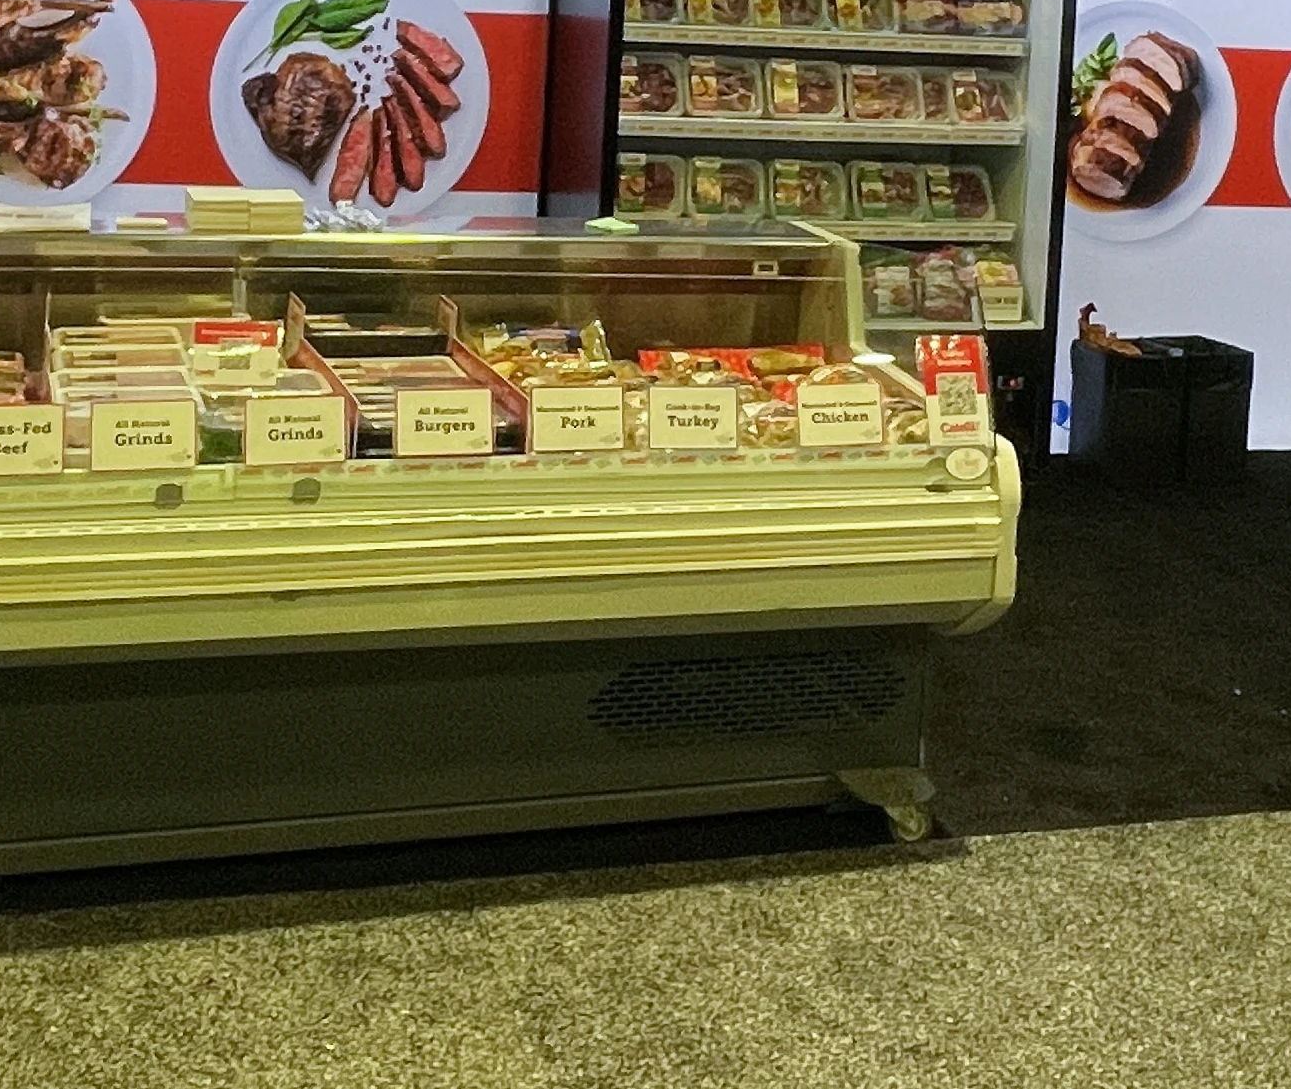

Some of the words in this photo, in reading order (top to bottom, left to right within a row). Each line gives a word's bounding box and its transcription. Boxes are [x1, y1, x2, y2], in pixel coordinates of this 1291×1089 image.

[560, 415, 596, 429] Pork
[667, 415, 720, 430] Turkey
[811, 411, 870, 424] Chicken
[267, 426, 324, 442] Grinds
[414, 418, 476, 435] Burgers
[114, 431, 173, 447] Grinds
